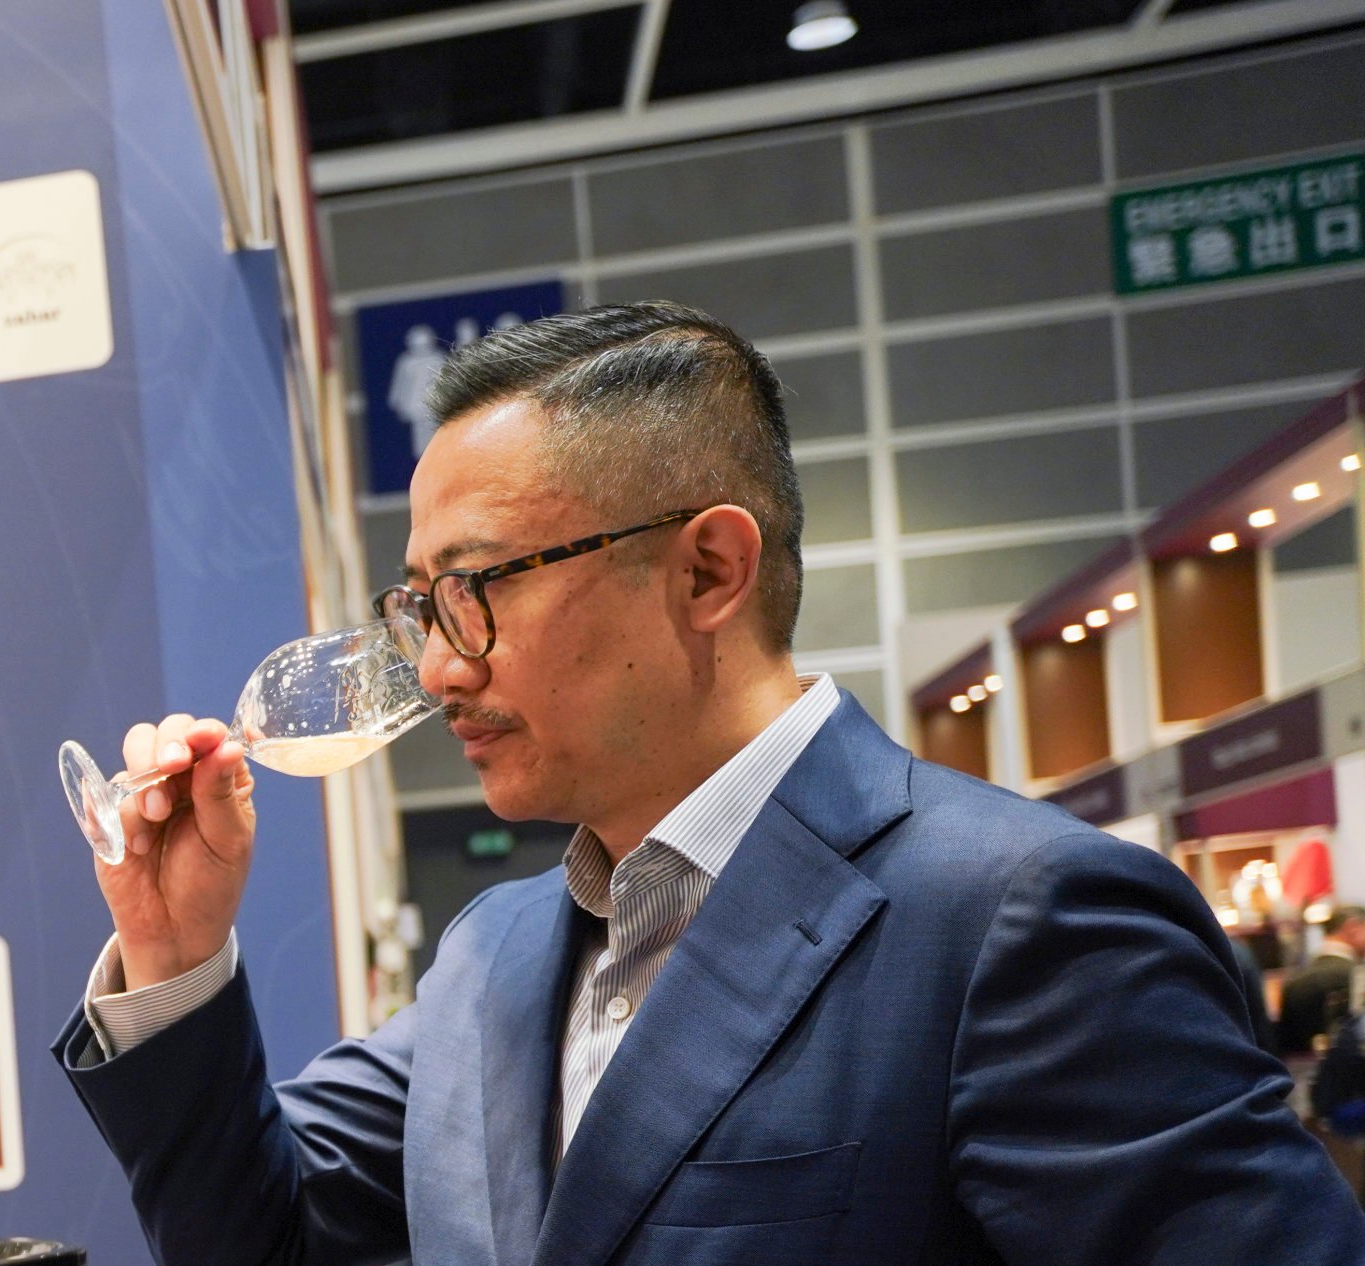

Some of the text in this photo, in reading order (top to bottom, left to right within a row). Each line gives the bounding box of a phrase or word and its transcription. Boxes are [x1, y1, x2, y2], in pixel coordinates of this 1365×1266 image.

[1125, 162, 1359, 235] EMERGENCY EXIT
[1128, 204, 1361, 287] 緊急出口
